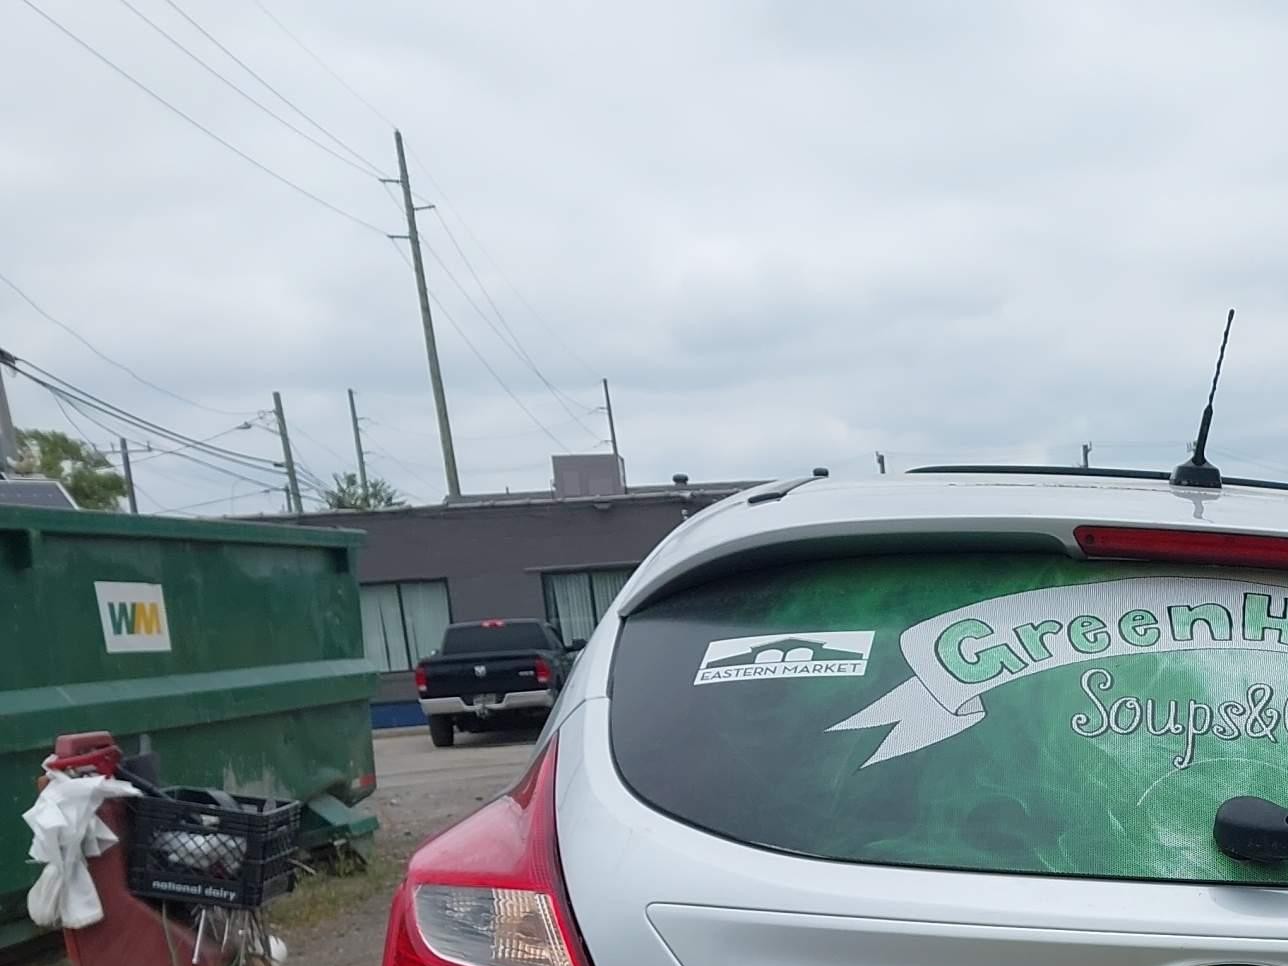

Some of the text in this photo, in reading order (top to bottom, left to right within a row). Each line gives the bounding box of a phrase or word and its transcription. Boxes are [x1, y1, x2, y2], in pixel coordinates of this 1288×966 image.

[107, 601, 162, 635] WM
[700, 662, 862, 681] EASTERN MARKET
[152, 880, 236, 901] national dairy
